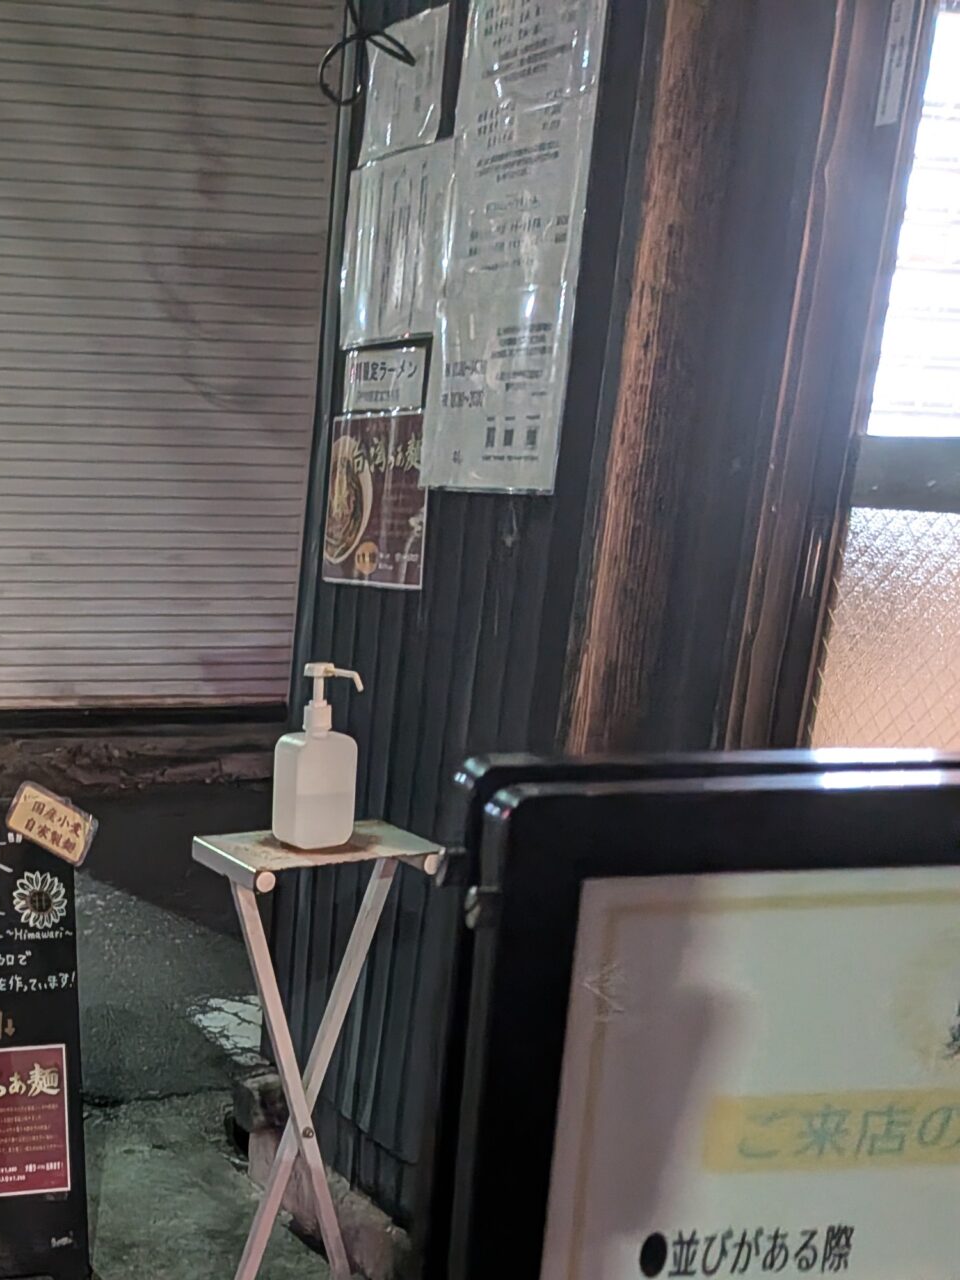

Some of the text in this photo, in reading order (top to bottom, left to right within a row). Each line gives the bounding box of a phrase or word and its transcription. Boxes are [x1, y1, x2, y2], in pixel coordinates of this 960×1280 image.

[738, 1102, 960, 1159] ご来店の
[667, 1224, 855, 1278] 並びがある際
